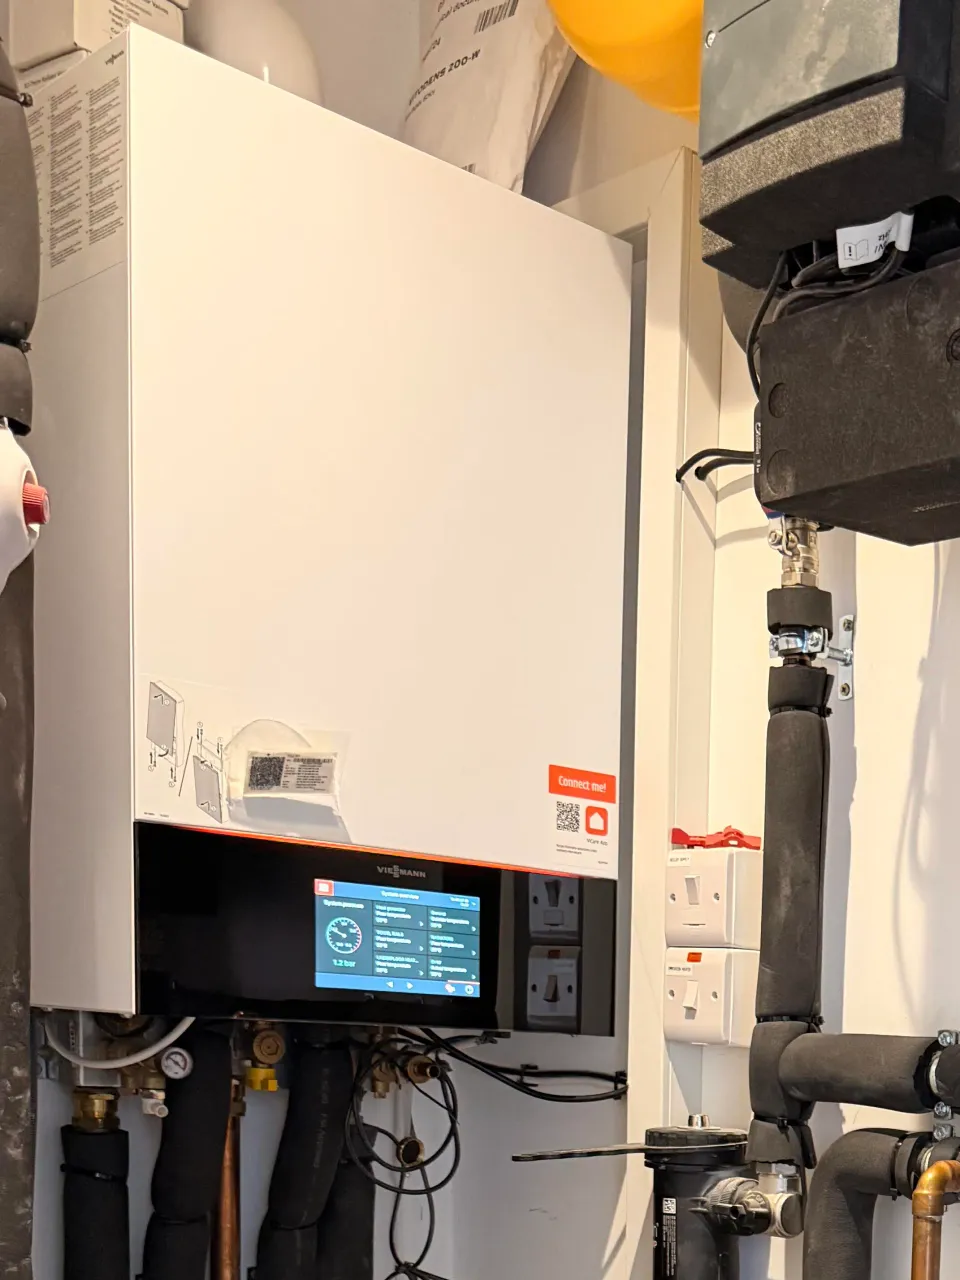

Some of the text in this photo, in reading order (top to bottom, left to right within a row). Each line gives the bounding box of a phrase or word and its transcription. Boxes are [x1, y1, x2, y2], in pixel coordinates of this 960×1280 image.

[558, 775, 607, 793] Connect me!
[377, 864, 426, 878] VIESSMANN
